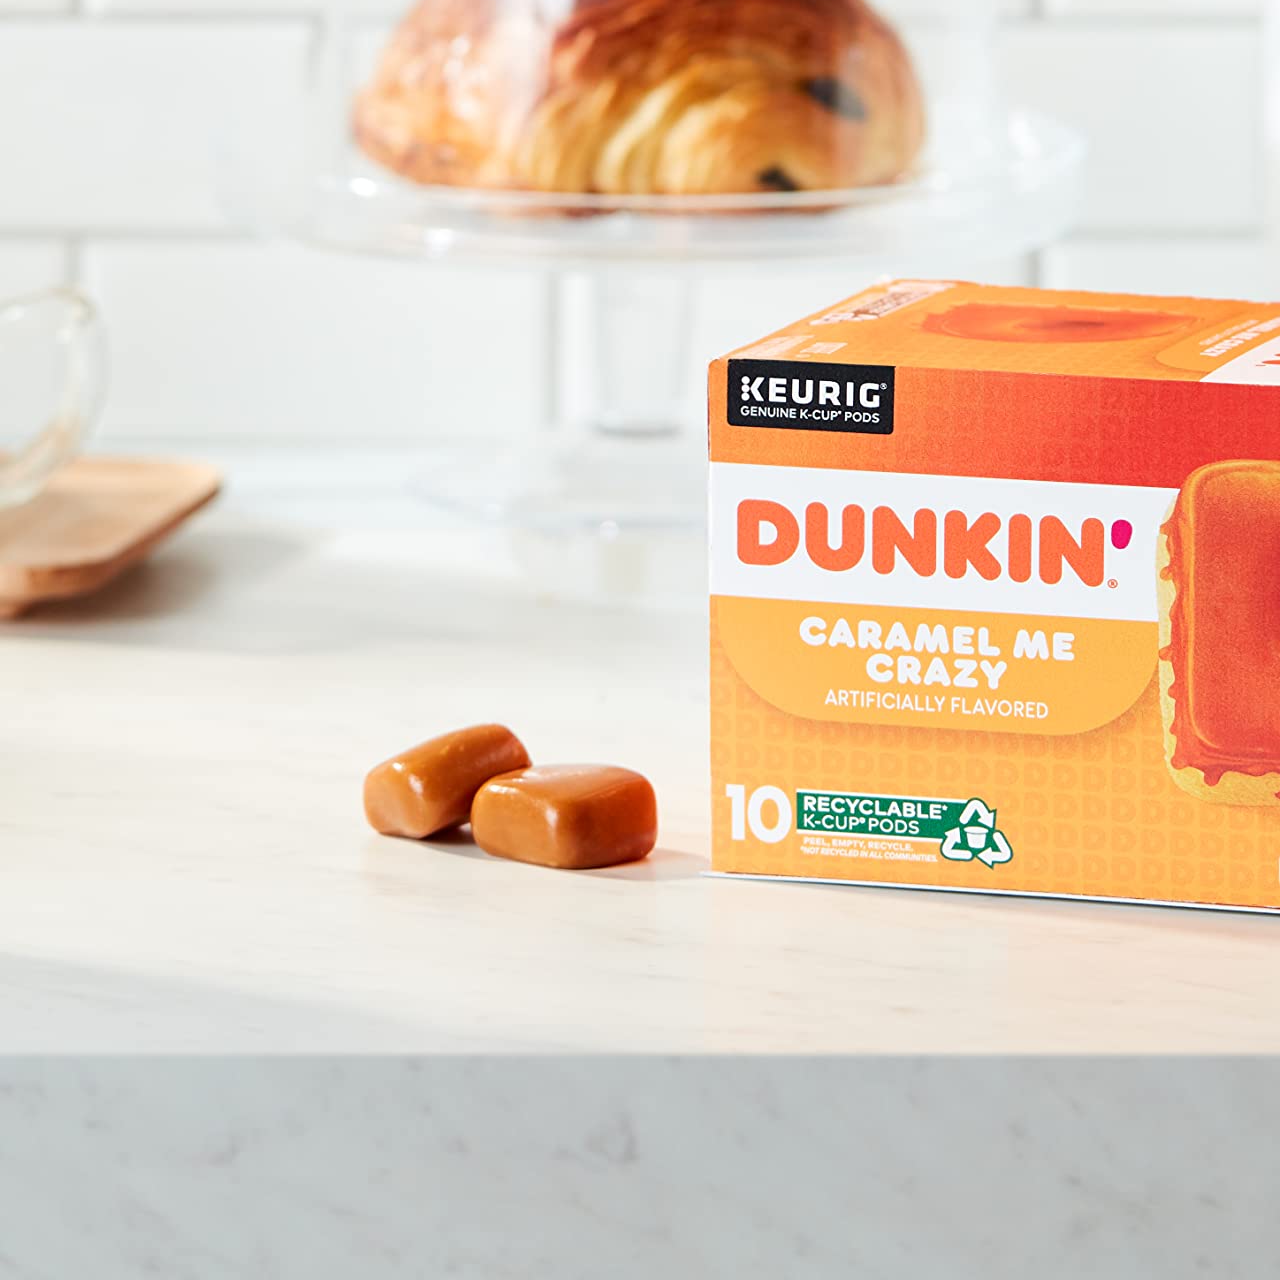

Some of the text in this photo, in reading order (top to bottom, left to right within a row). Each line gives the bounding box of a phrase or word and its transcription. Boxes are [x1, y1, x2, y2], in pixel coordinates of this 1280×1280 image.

[741, 375, 881, 408] KEURIG
[740, 405, 797, 419] GENUINE
[844, 411, 880, 423] PODS
[737, 499, 1133, 588] DUNKIN'
[799, 616, 1075, 661] CARAMEL ME
[865, 653, 1007, 690] CRAZY
[824, 688, 1049, 719] ARTIFICIALLY FLAVORED
[725, 783, 792, 844] 10
[868, 818, 920, 834] PODS
[803, 836, 913, 852] PEEL, EMPTY, RECYCLE.
